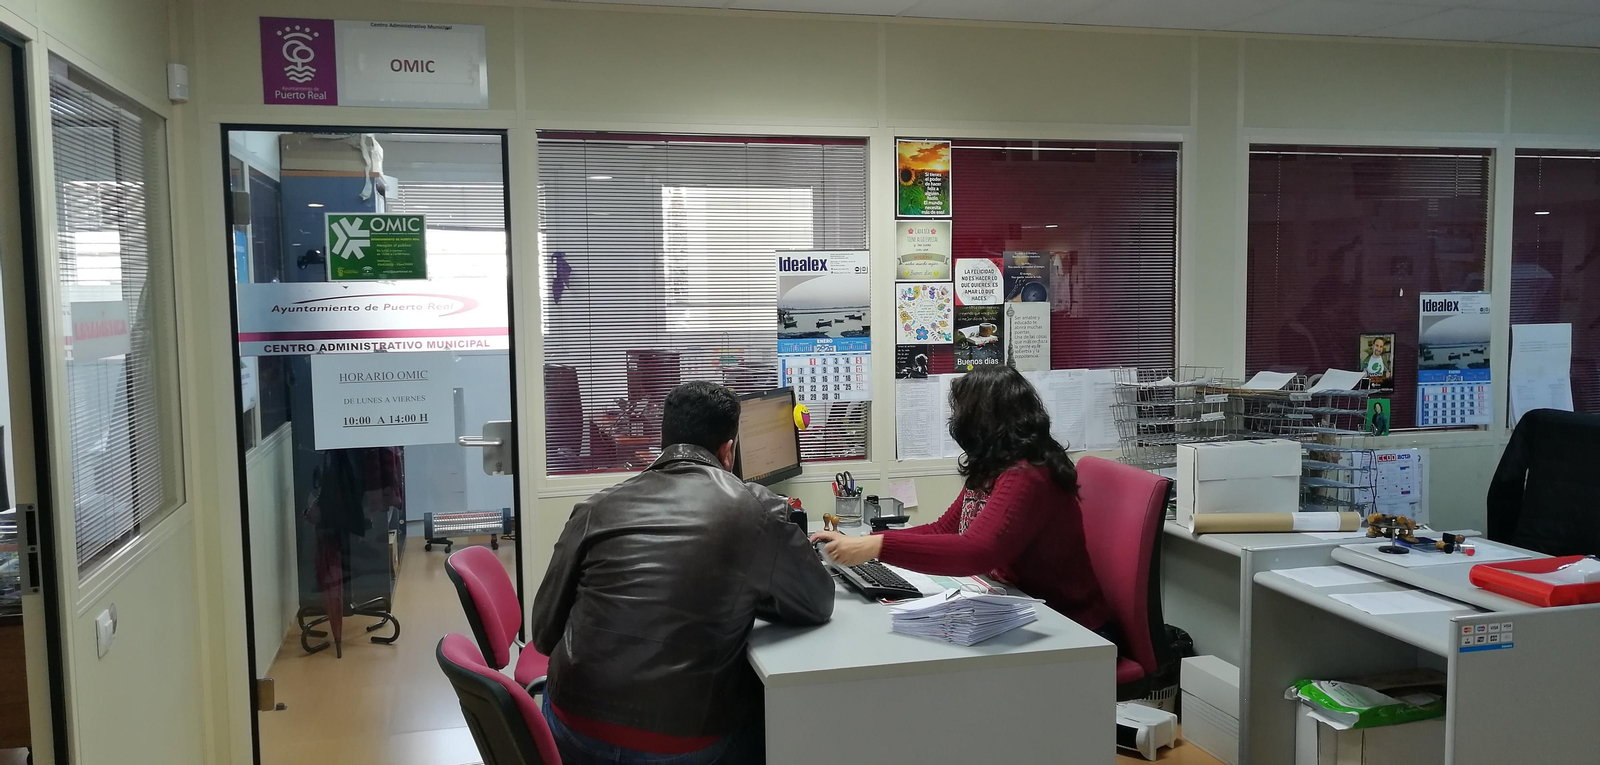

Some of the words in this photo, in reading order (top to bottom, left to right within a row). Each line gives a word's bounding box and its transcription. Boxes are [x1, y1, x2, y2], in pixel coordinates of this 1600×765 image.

[390, 58, 436, 74] OMIC
[275, 90, 306, 99] Puerto
[307, 91, 326, 100] Real
[370, 217, 420, 232] OMIC
[779, 257, 828, 272] Idealex
[271, 304, 360, 314] Ayuntamiento
[365, 303, 379, 312] de
[383, 302, 423, 311] Puerto
[428, 302, 453, 311] Real
[1422, 299, 1459, 312] Idealex
[264, 343, 316, 354] CENTRO
[318, 340, 424, 352] ADMINISTRATIVO
[426, 339, 491, 350] MUNICIPAL
[339, 371, 394, 382] HORARIO
[396, 370, 428, 381] OMIC
[356, 396, 382, 405] LUNES
[392, 395, 426, 403] VIERNES
[343, 416, 371, 426] 10:00
[377, 415, 385, 425] A
[388, 414, 416, 424] 14:00
[419, 413, 428, 423] H
